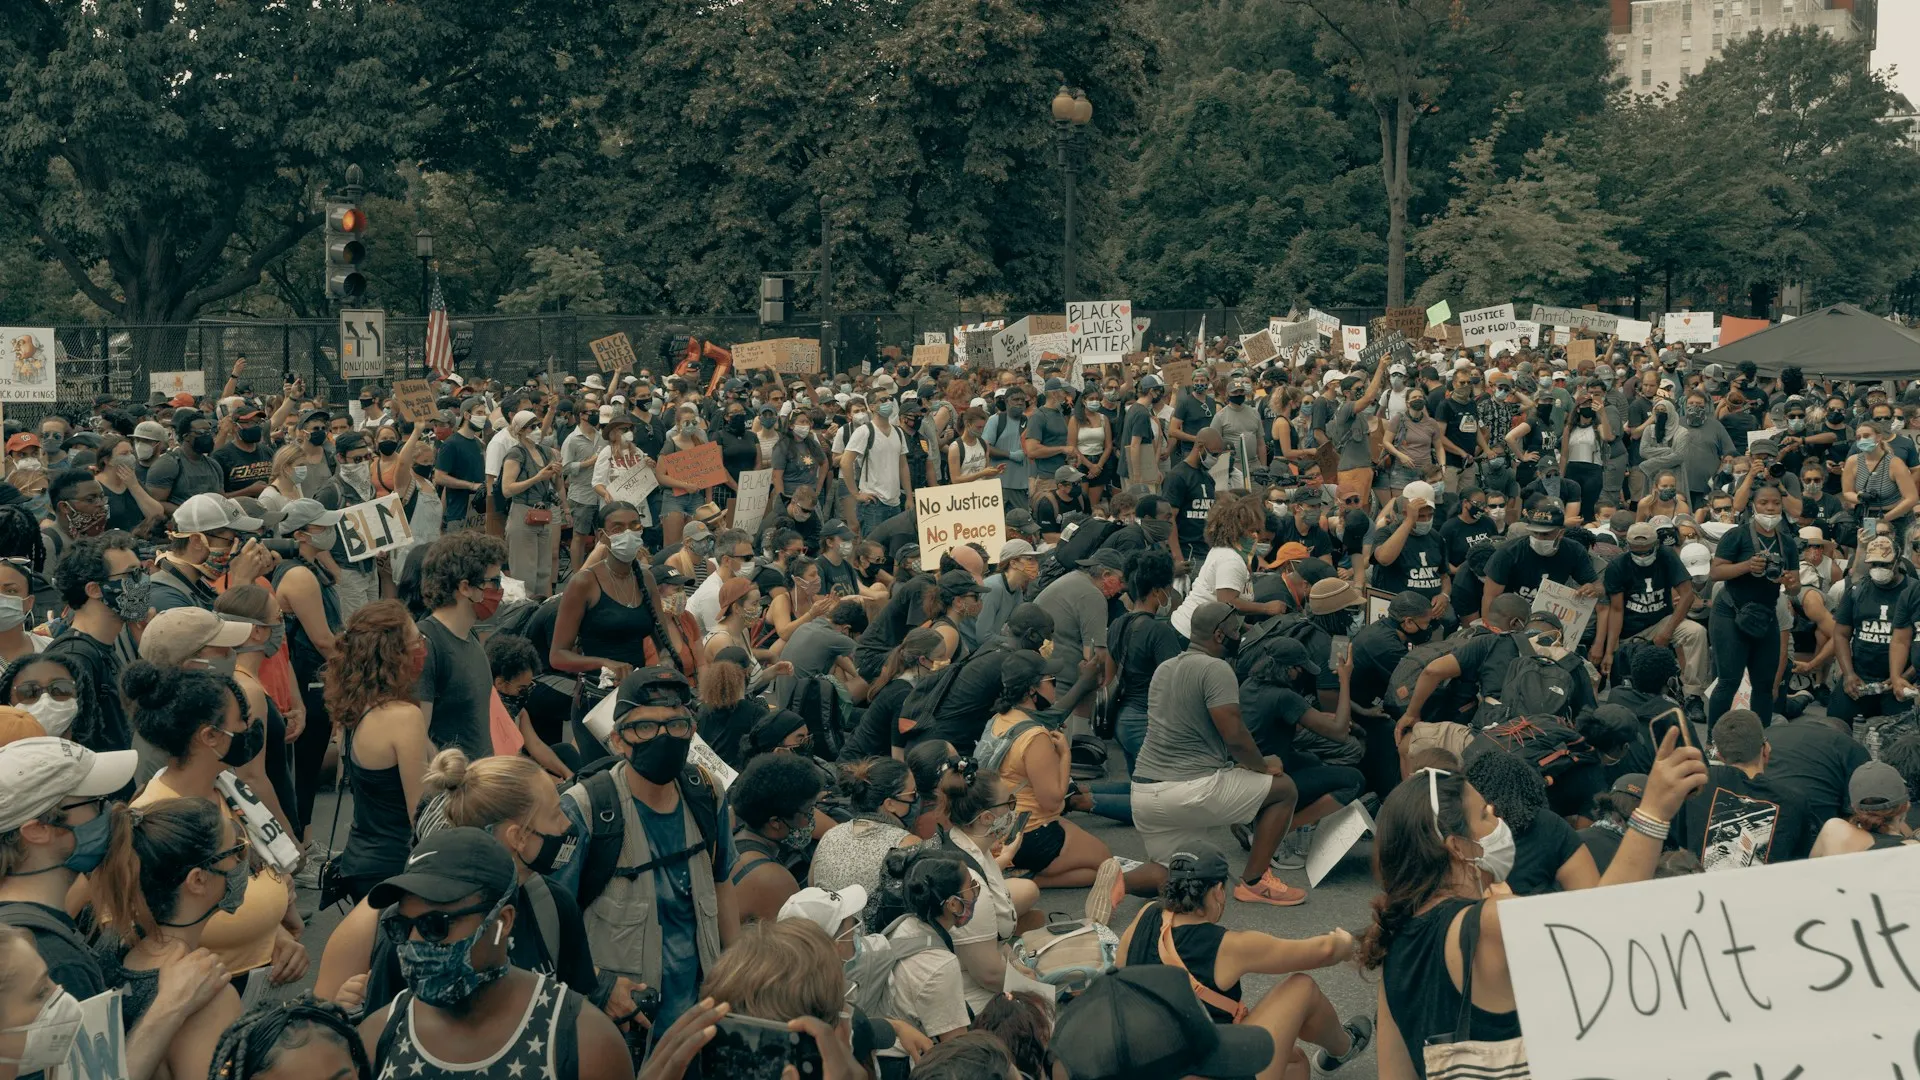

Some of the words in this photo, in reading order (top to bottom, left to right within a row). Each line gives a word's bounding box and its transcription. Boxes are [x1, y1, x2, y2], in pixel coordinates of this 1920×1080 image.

[1069, 303, 1120, 324] BLACK
[1387, 307, 1423, 317] GENERAL
[1463, 309, 1505, 323] JUSTICE
[1036, 317, 1062, 331] Police
[1082, 320, 1123, 335] LIVES
[1348, 327, 1360, 335] NO
[1465, 326, 1485, 336] FOR
[1488, 322, 1517, 333] FLOYD
[596, 335, 627, 353] BLACK
[1001, 333, 1015, 349] We
[1006, 335, 1028, 357] Stand
[1071, 334, 1130, 354] MATTER
[1348, 342, 1361, 350] NO
[600, 346, 631, 362] LIVES
[734, 346, 745, 354] IF
[343, 360, 361, 371] ONLY
[364, 360, 382, 371] ONLY
[603, 355, 635, 371] MATTER
[14, 390, 31, 399] OUT
[32, 390, 55, 399] KINGS
[623, 475, 638, 491] REAL
[742, 472, 769, 490] BLACK
[1201, 484, 1207, 498] I
[919, 497, 940, 515] No
[946, 492, 999, 512] Justice
[1186, 510, 1208, 519] BREA
[339, 498, 412, 557] BLM
[926, 526, 948, 544] No
[953, 522, 996, 541] Peace
[1466, 532, 1489, 543] BLACK
[1419, 551, 1428, 567] I
[1407, 579, 1442, 589] BREATH
[1644, 577, 1654, 593] I
[1630, 588, 1665, 603] CAN'T
[1545, 601, 1583, 625] STUDY
[1625, 599, 1668, 614] BREATHE.
[1879, 604, 1889, 620] I
[1861, 620, 1892, 634] CAN
[1858, 631, 1892, 644] REATH
[1544, 891, 1773, 1041] Don't
[1794, 887, 1920, 992] sit
